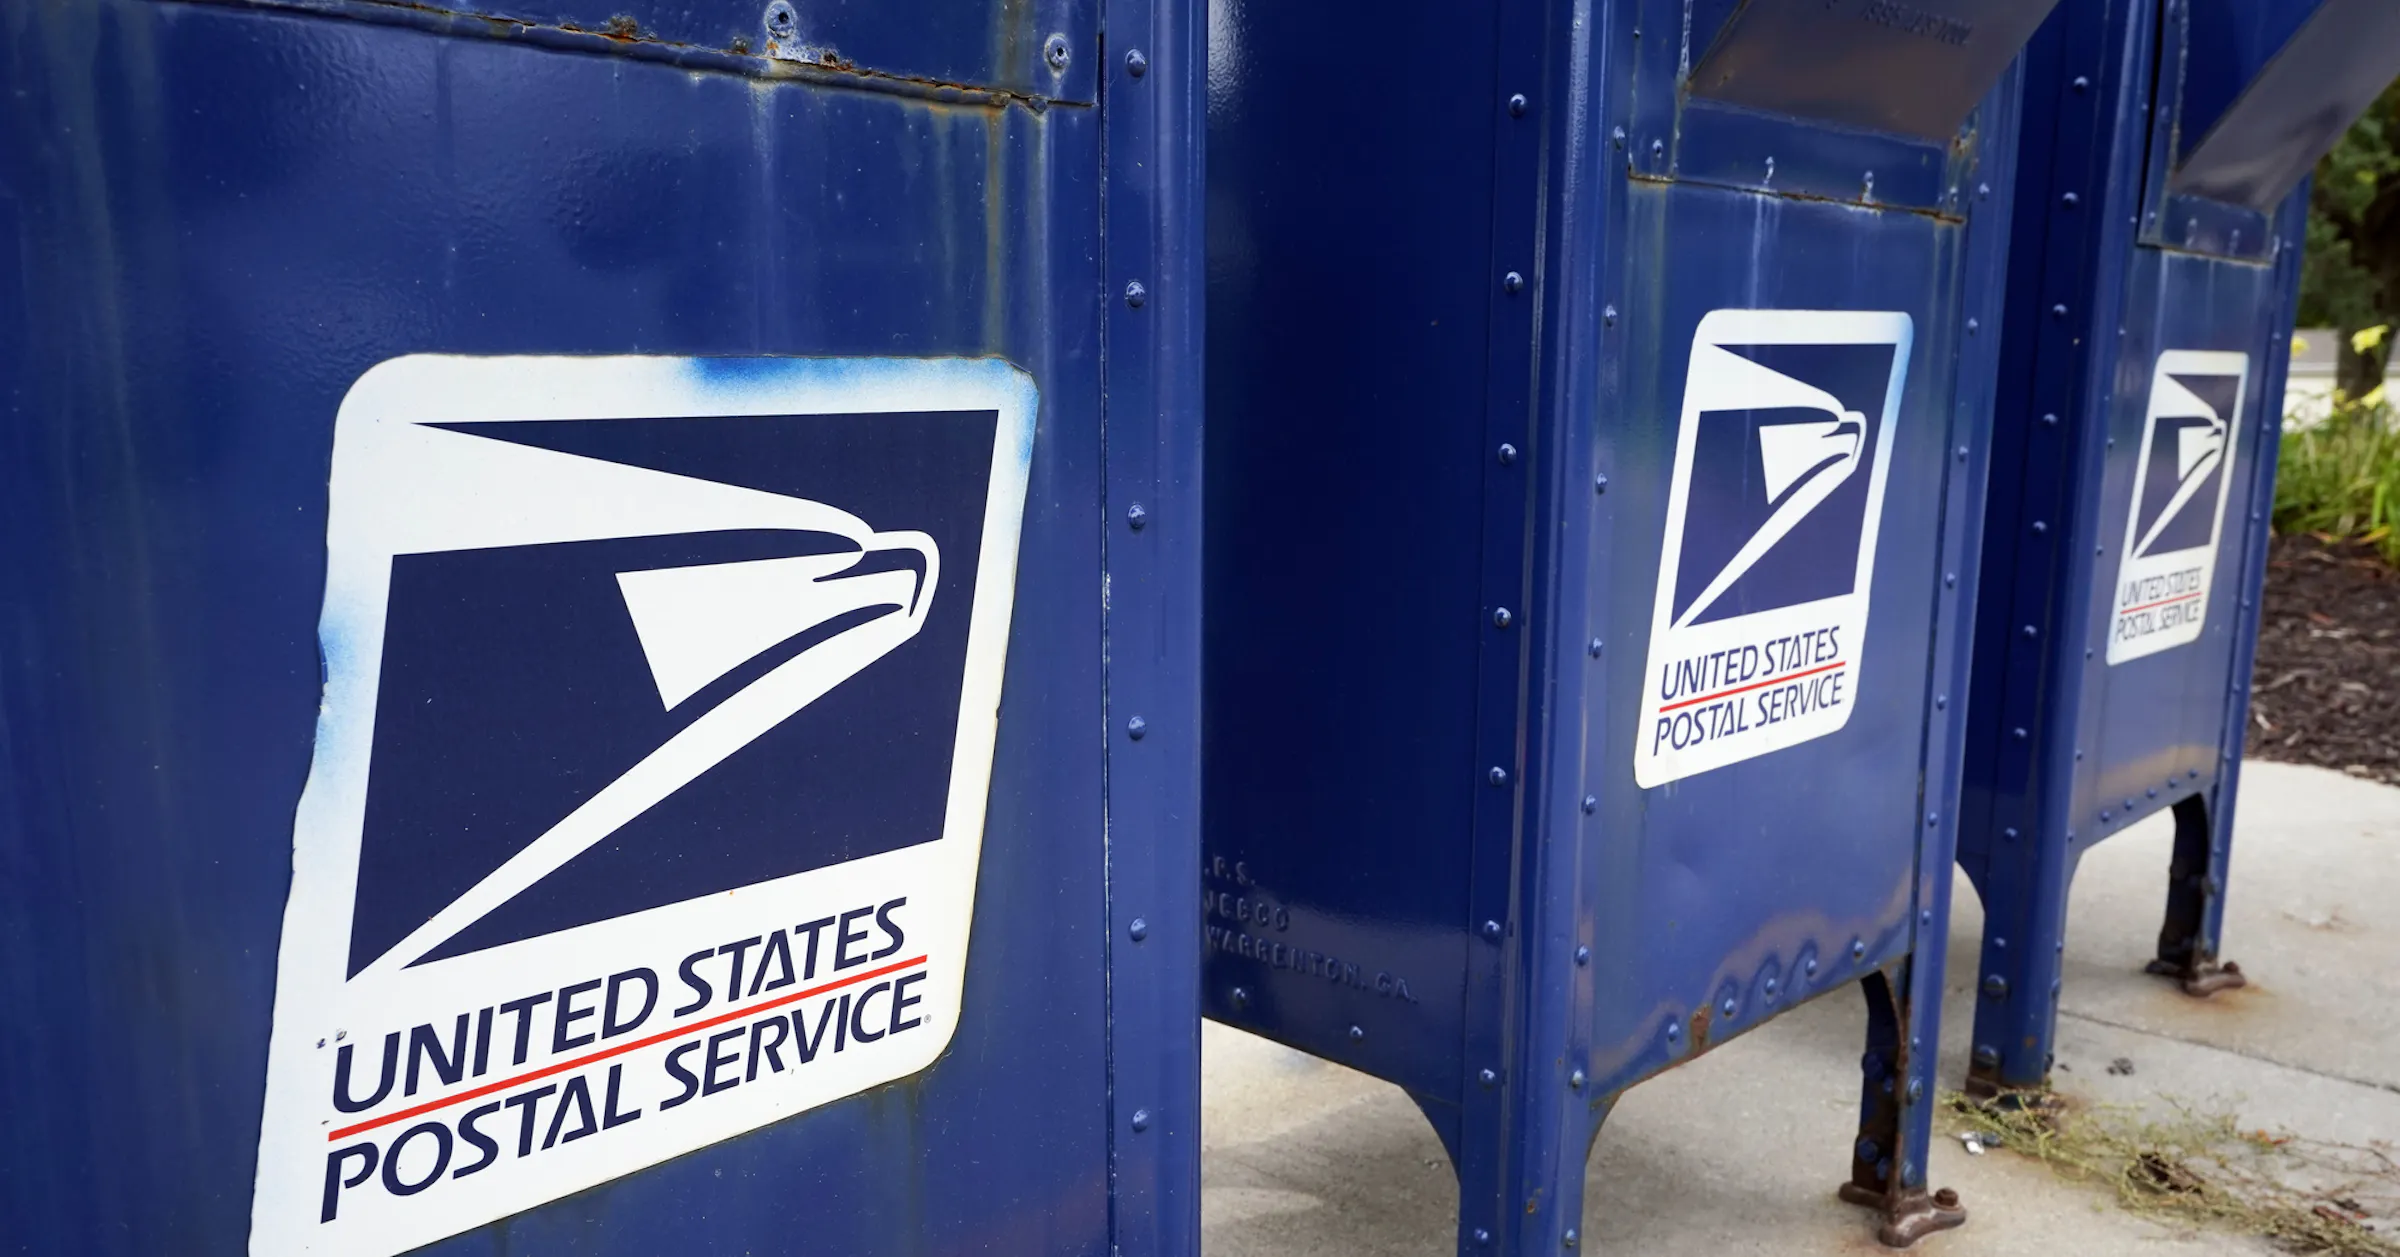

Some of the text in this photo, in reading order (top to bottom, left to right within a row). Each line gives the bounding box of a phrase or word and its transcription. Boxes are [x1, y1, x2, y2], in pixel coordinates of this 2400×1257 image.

[1653, 671, 1844, 757] POSTAL SERVICE
[1661, 625, 1840, 700] UNITED STATES
[332, 896, 908, 1114] UNITED STATES
[320, 1063, 642, 1225] POSTAL
